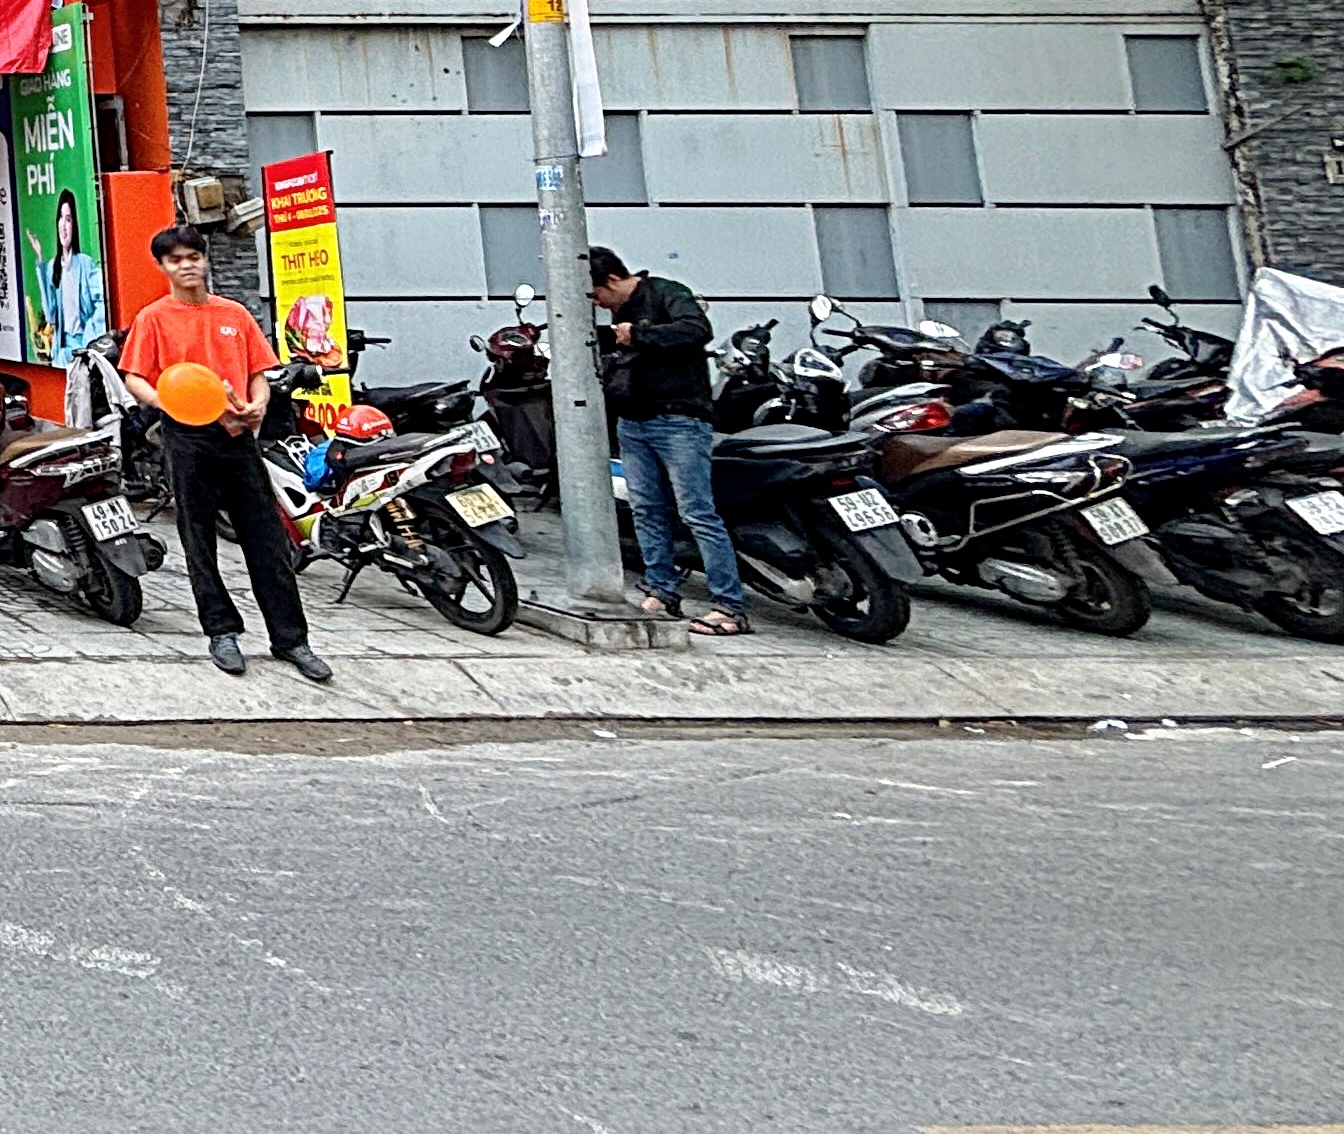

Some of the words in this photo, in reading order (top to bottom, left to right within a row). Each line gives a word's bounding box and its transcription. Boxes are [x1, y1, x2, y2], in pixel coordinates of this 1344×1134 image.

[23, 95, 75, 153] MIỄN
[27, 152, 56, 196] PHÍ
[281, 252, 306, 274] THỊT
[308, 249, 329, 267] HEO
